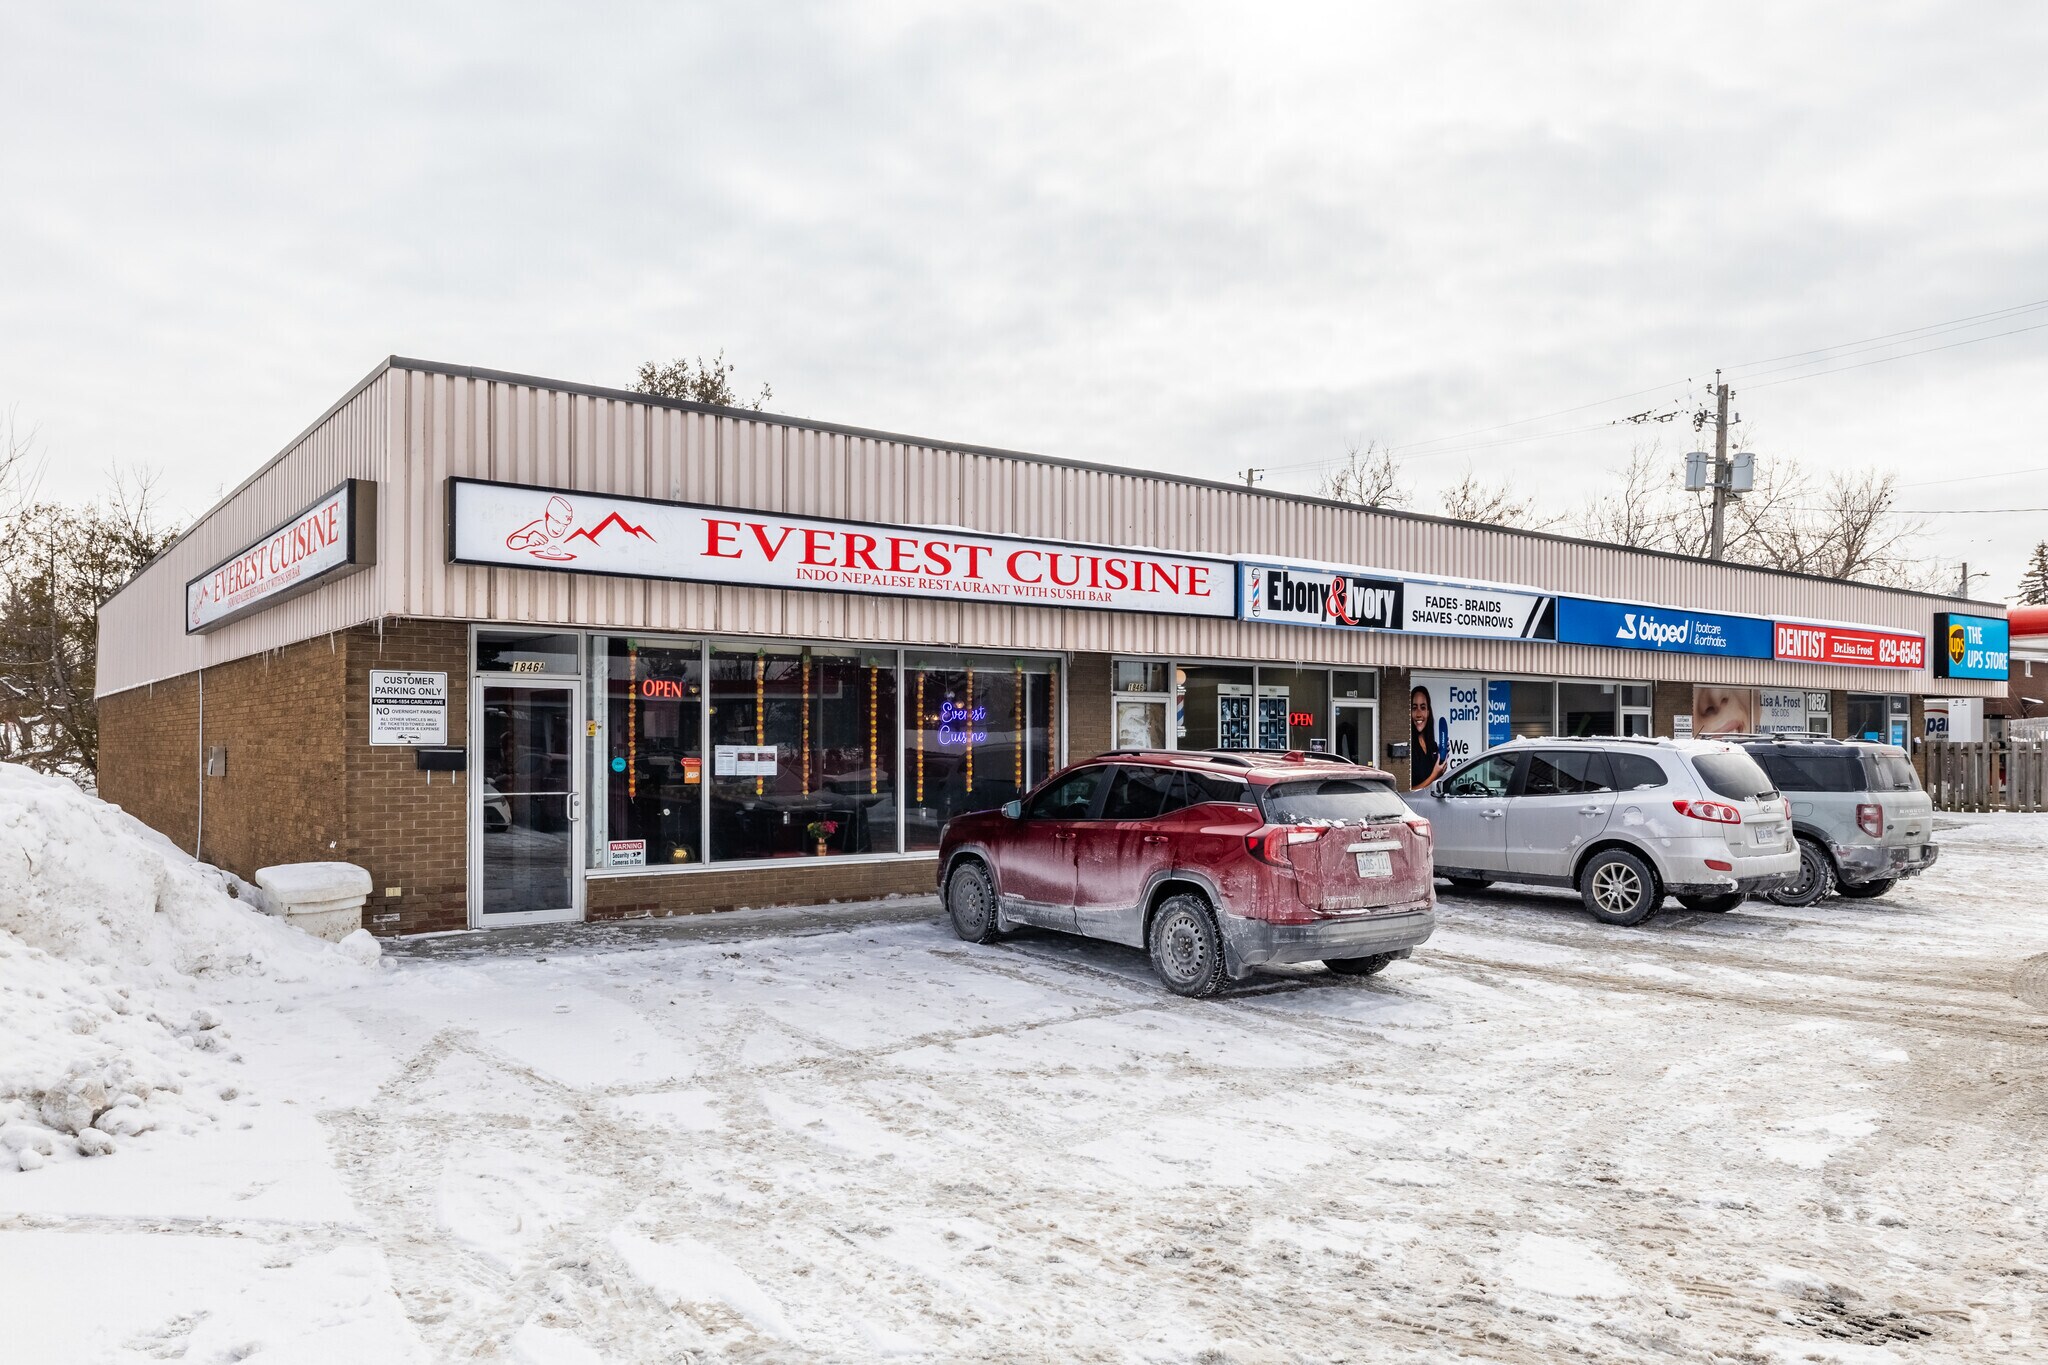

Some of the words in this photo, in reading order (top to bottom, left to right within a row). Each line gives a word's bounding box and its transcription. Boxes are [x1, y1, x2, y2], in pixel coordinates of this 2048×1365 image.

[214, 546, 267, 602] EVEREST
[269, 502, 339, 574] CUISINE
[700, 518, 993, 580] EVEREST
[1006, 549, 1211, 597] CUISINE
[796, 568, 838, 582] INDO
[842, 572, 915, 588] NEPALESE
[918, 578, 1010, 595] RESTAURANT
[1013, 585, 1047, 598] WITH
[1050, 588, 1086, 600] SUSHI
[1088, 590, 1112, 602] BAR
[1268, 571, 1331, 622] Ebony
[1345, 578, 1395, 628] Ivory
[1425, 596, 1458, 610] FADES
[1465, 599, 1501, 613] BRAIDS
[1412, 610, 1452, 624] SHAVES
[1639, 615, 1689, 647] bioped
[1695, 621, 1721, 634] footcare
[1967, 625, 1983, 645] THE
[1778, 627, 1826, 658] DENTIST
[1856, 644, 1873, 656] Frost
[1879, 638, 1922, 664] 829-6545
[1950, 637, 1965, 659] ups
[1967, 650, 1983, 669] UPS
[1985, 651, 2008, 670] STORE
[383, 676, 435, 685] CUSTOMER
[642, 679, 683, 698] OPEN
[375, 686, 416, 695] PARKING
[418, 687, 442, 696] ONLY
[1450, 686, 1477, 703] Foot
[1488, 700, 1506, 711] Now
[1760, 694, 1773, 707] Lisa
[1775, 695, 1782, 707] A.
[1783, 695, 1801, 708] Frost
[1808, 693, 1826, 711] 1852
[376, 707, 390, 715] NO
[1289, 712, 1313, 726] OPEN
[1450, 705, 1480, 724] pain?
[1488, 712, 1510, 725] Open
[939, 725, 987, 745] Cuisne
[1450, 740, 1469, 755] We
[1361, 828, 1390, 840] GMC
[612, 851, 630, 859] Security
